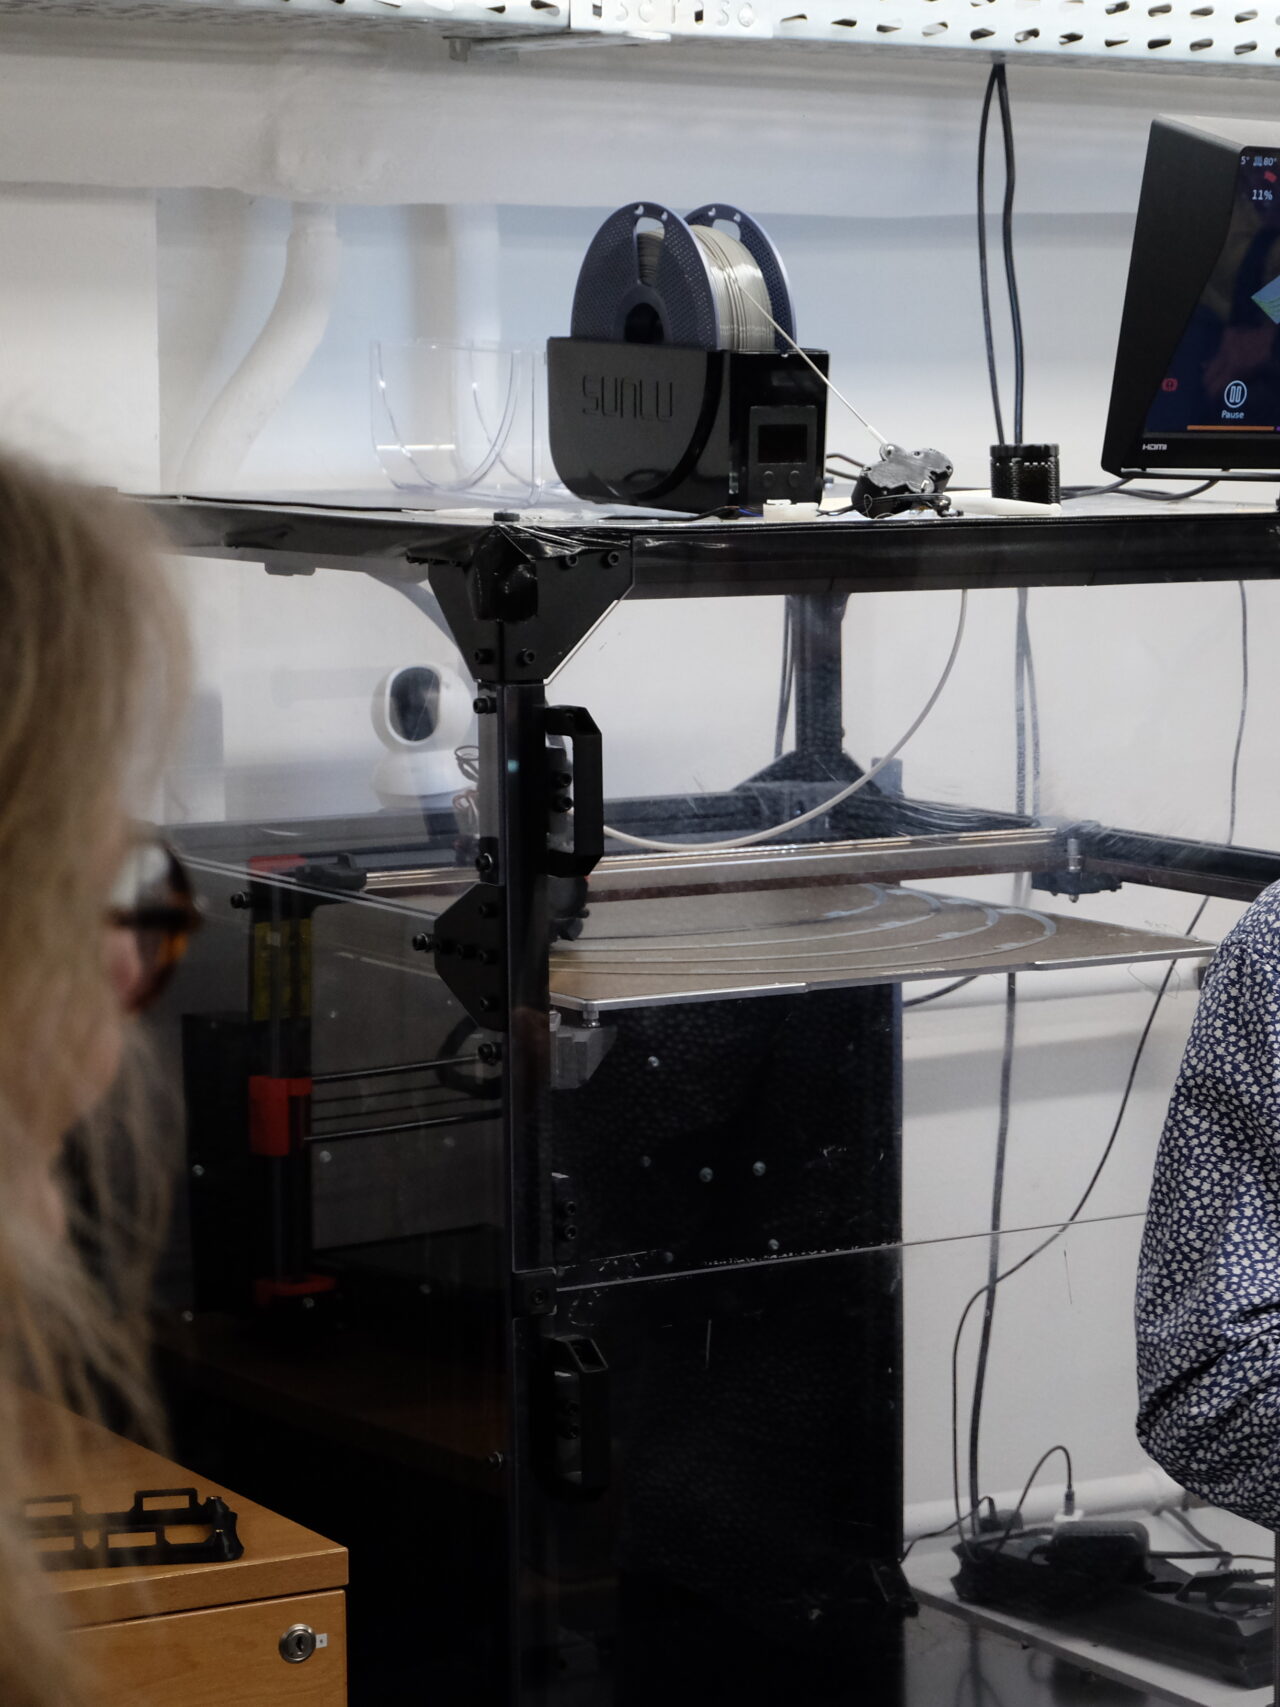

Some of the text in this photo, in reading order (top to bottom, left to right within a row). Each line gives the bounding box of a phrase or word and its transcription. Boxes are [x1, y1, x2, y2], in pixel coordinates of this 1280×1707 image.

[1251, 189, 1273, 201] 11%
[582, 374, 673, 422] SUNLU
[1221, 410, 1245, 420] Pause
[1142, 443, 1168, 451] HDMI
